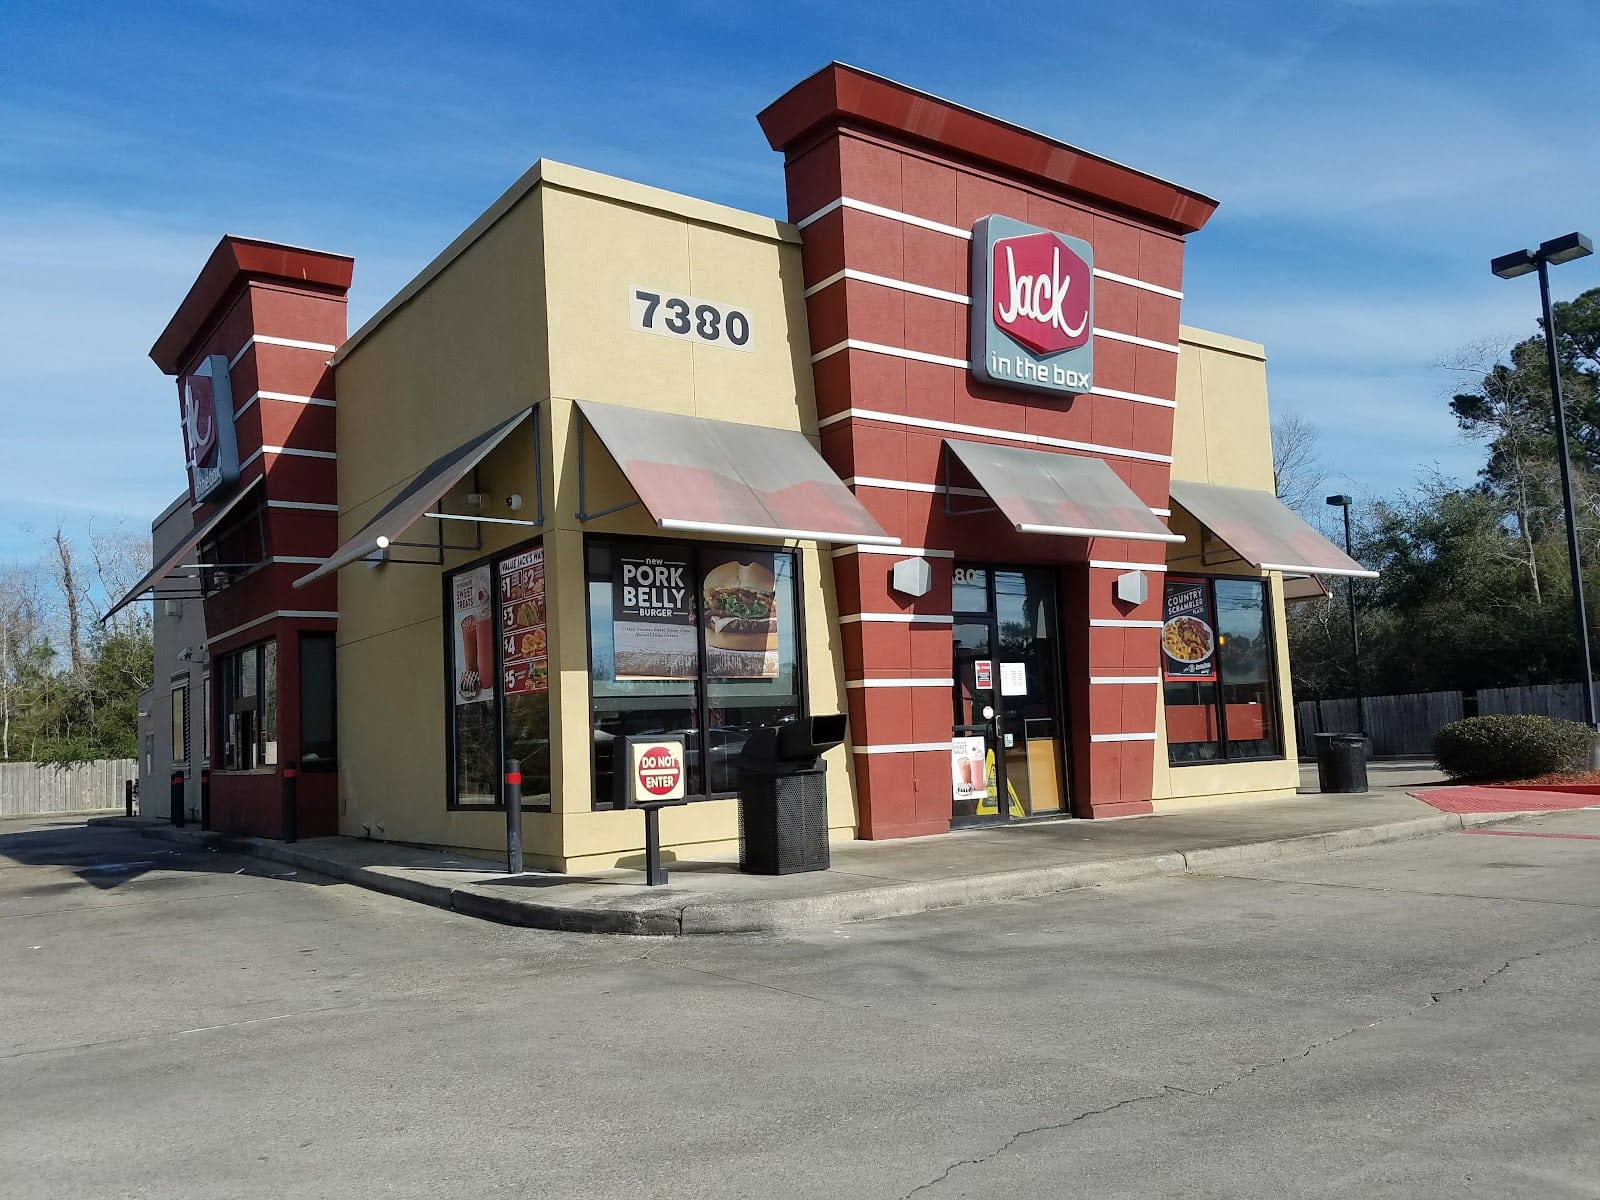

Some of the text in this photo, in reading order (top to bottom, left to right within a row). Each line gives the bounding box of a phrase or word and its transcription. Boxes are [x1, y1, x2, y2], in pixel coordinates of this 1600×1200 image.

[998, 245, 1087, 338] Jack
[635, 290, 750, 346] 7380
[991, 350, 1091, 388] in the box
[502, 558, 517, 573] VALUE
[645, 557, 664, 566] new
[523, 568, 535, 589] $2
[623, 564, 685, 588] PORK
[456, 586, 473, 601] SWEET
[502, 577, 511, 598] $1
[456, 598, 474, 610] TREATS
[623, 586, 686, 609] BELLY
[1167, 589, 1203, 607] COUNTRY
[1168, 598, 1203, 616] SCRAMBLER
[503, 606, 514, 626] $3
[639, 608, 673, 617] BURGER
[504, 635, 516, 655] $4
[505, 670, 515, 689] $5
[642, 755, 677, 768] DO NOT
[646, 776, 674, 789] ENTER
